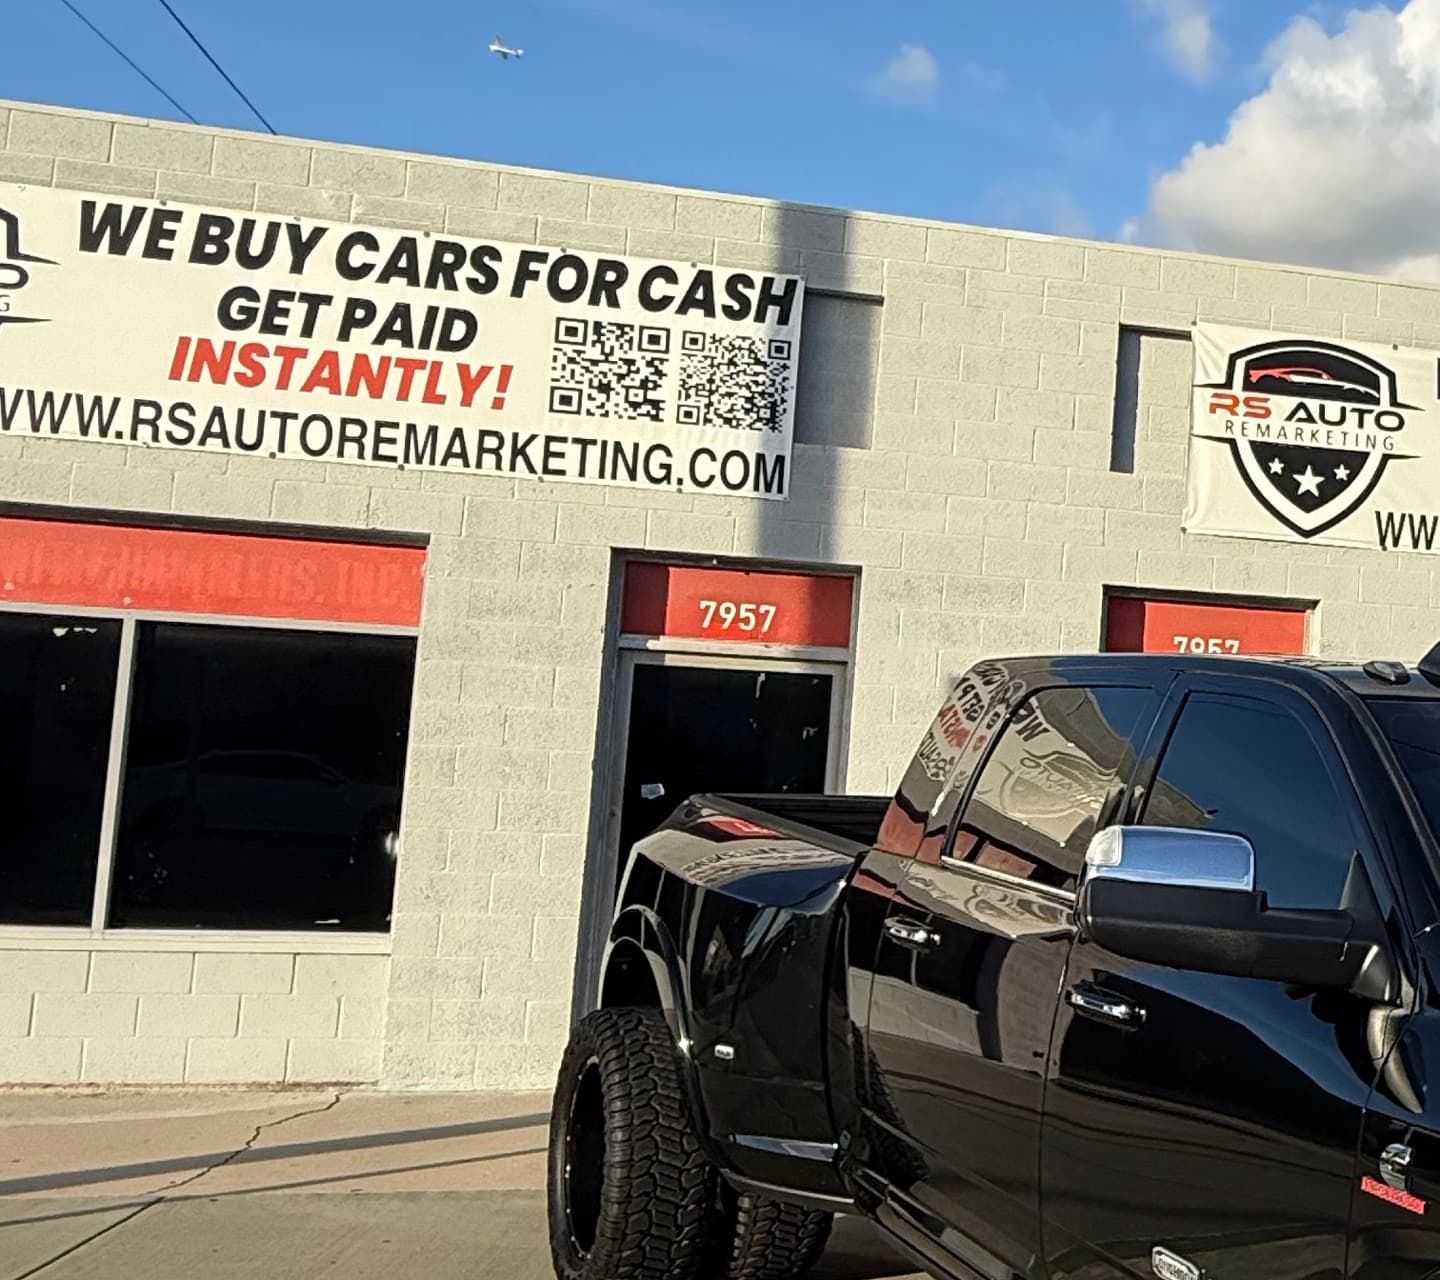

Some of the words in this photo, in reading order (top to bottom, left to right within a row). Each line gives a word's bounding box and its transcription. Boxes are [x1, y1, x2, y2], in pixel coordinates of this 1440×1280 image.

[78, 200, 184, 262] WE
[188, 214, 330, 275] BUY
[335, 231, 503, 295] CARS
[510, 249, 629, 309] FOR
[637, 264, 799, 326] CASH
[217, 285, 333, 338] GET
[336, 297, 478, 353] PAID
[168, 336, 514, 410] INSTANTLY!
[1209, 393, 1272, 419] RS
[1284, 401, 1406, 432] AUTO
[1224, 420, 1395, 451] REMARKETING
[700, 600, 777, 633] 7957
